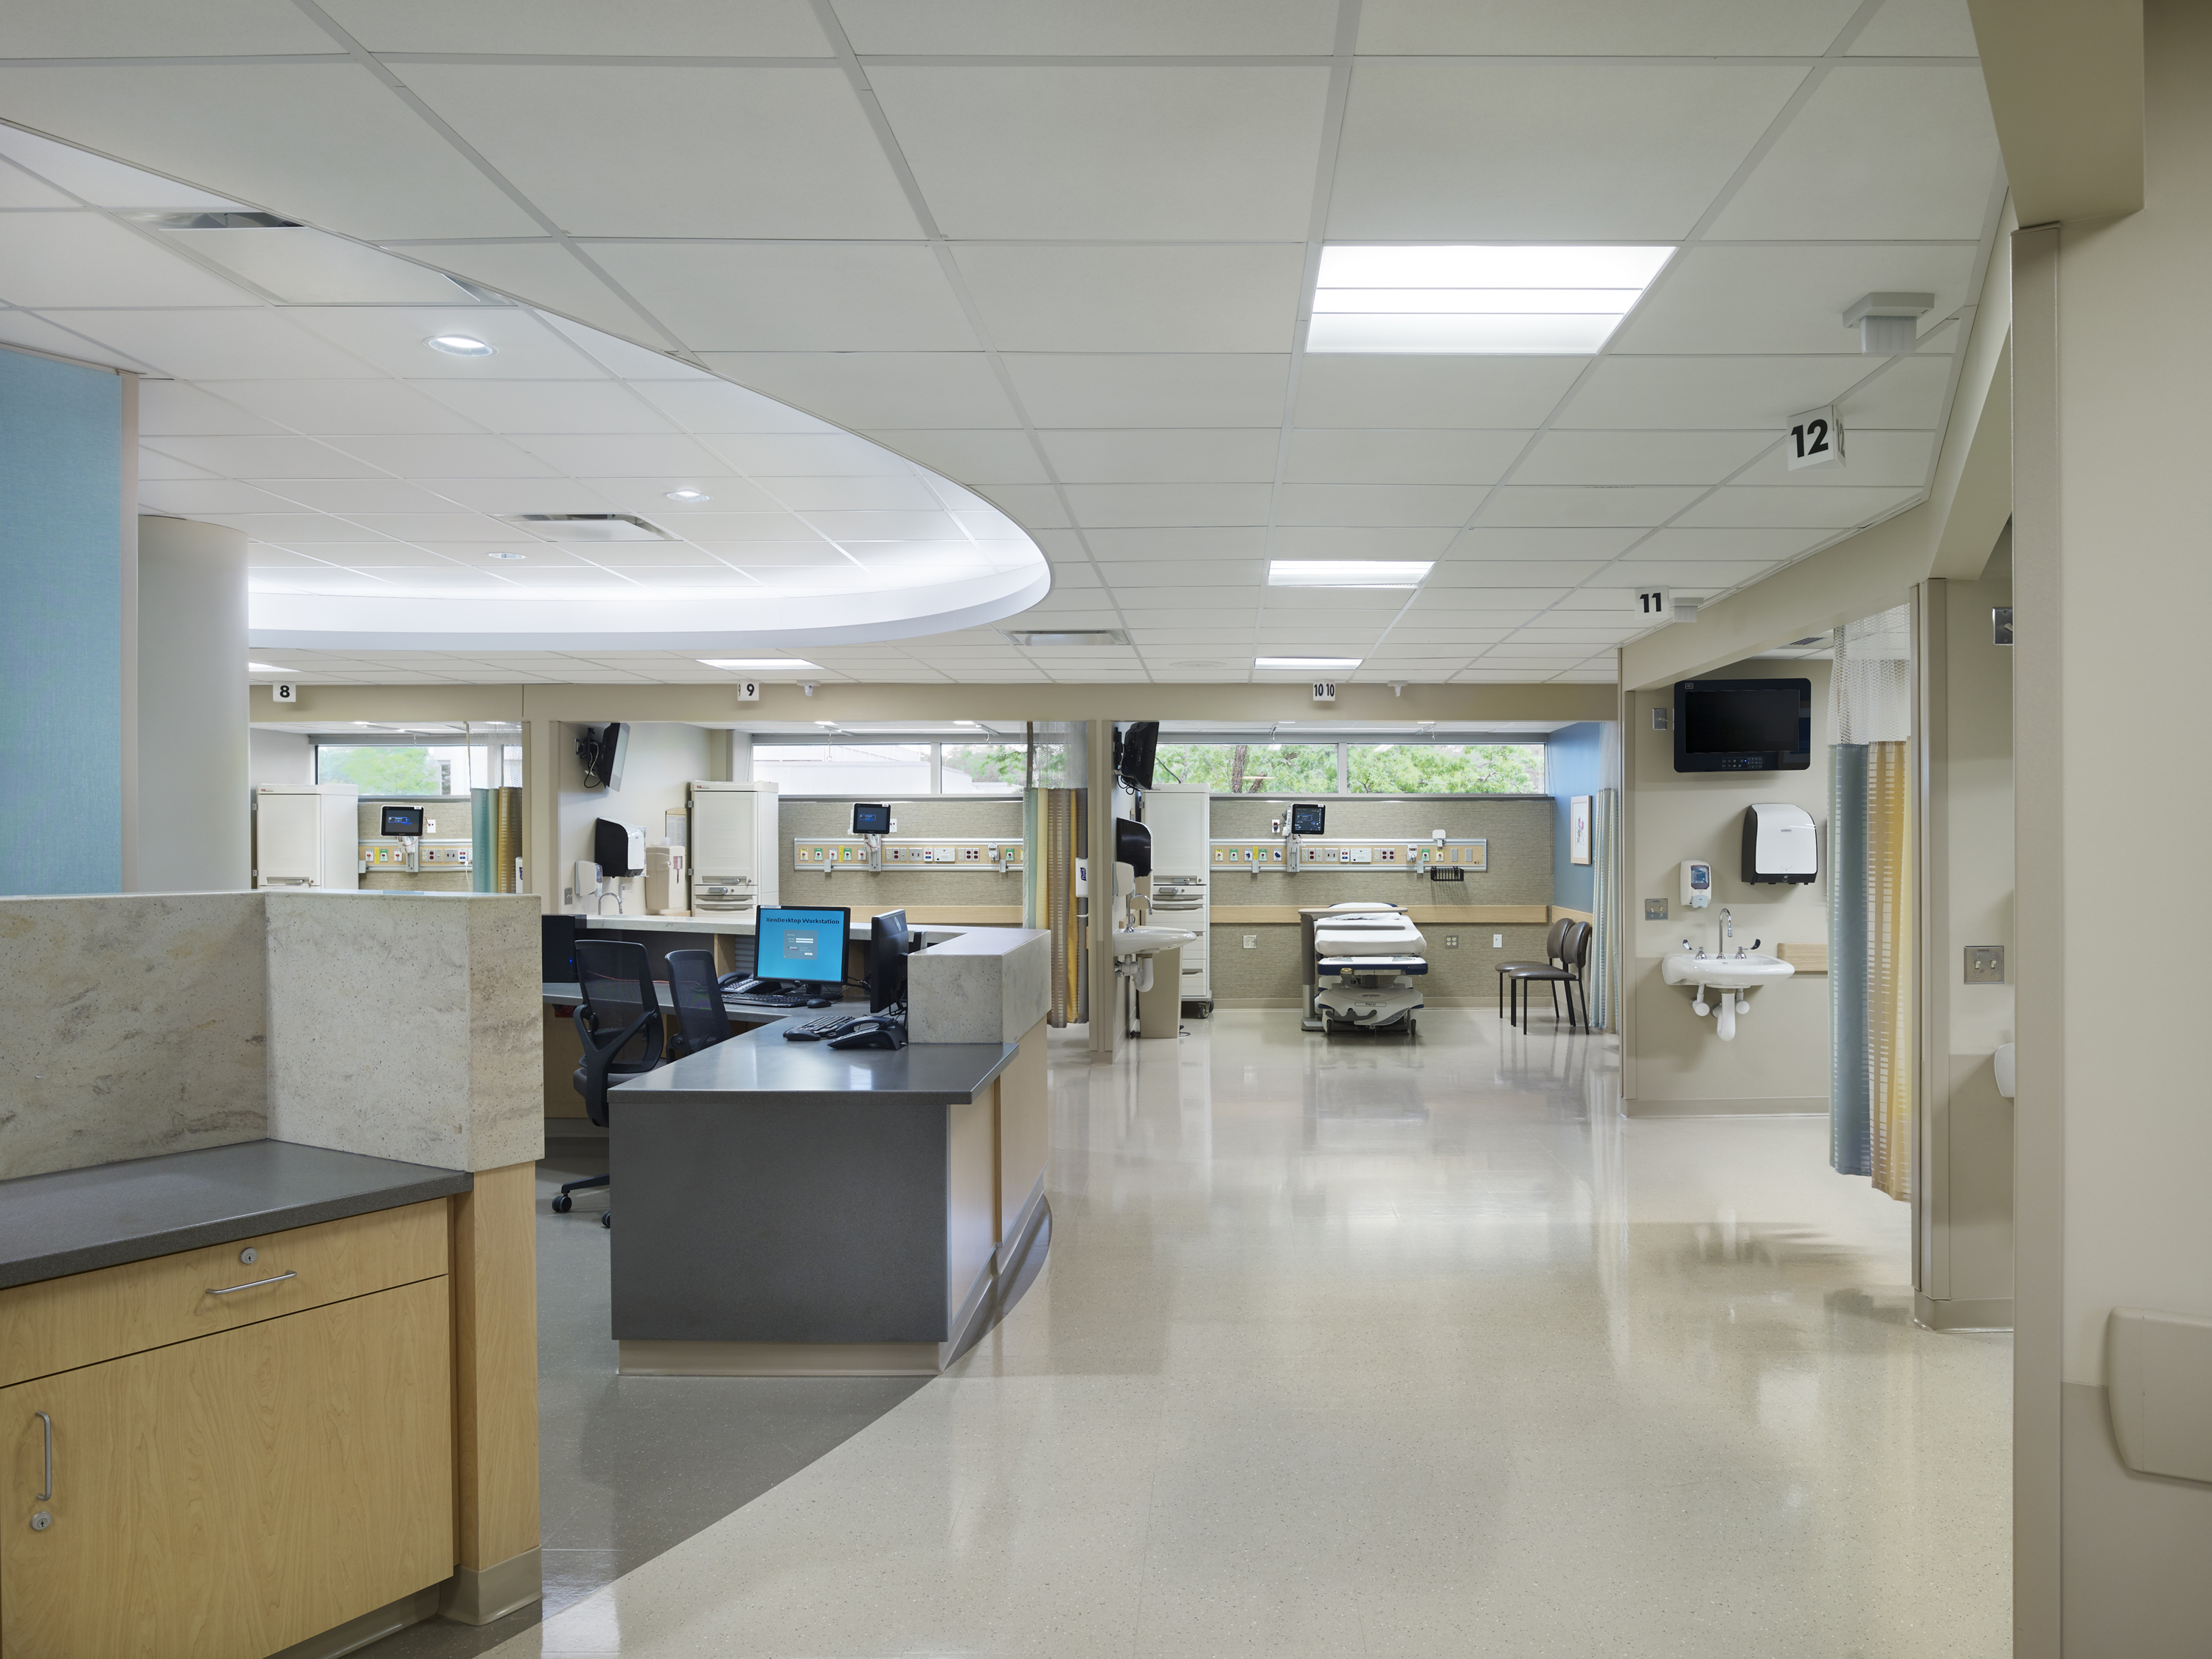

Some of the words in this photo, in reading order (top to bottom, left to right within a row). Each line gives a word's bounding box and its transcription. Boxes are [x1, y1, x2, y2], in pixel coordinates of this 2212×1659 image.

[1790, 418, 1829, 459] 12
[1836, 417, 1846, 459] 12
[1639, 592, 1662, 613] 11
[279, 685, 290, 698] 8
[746, 683, 755, 697] 9
[1314, 683, 1324, 697] 10
[1326, 683, 1335, 697] 10
